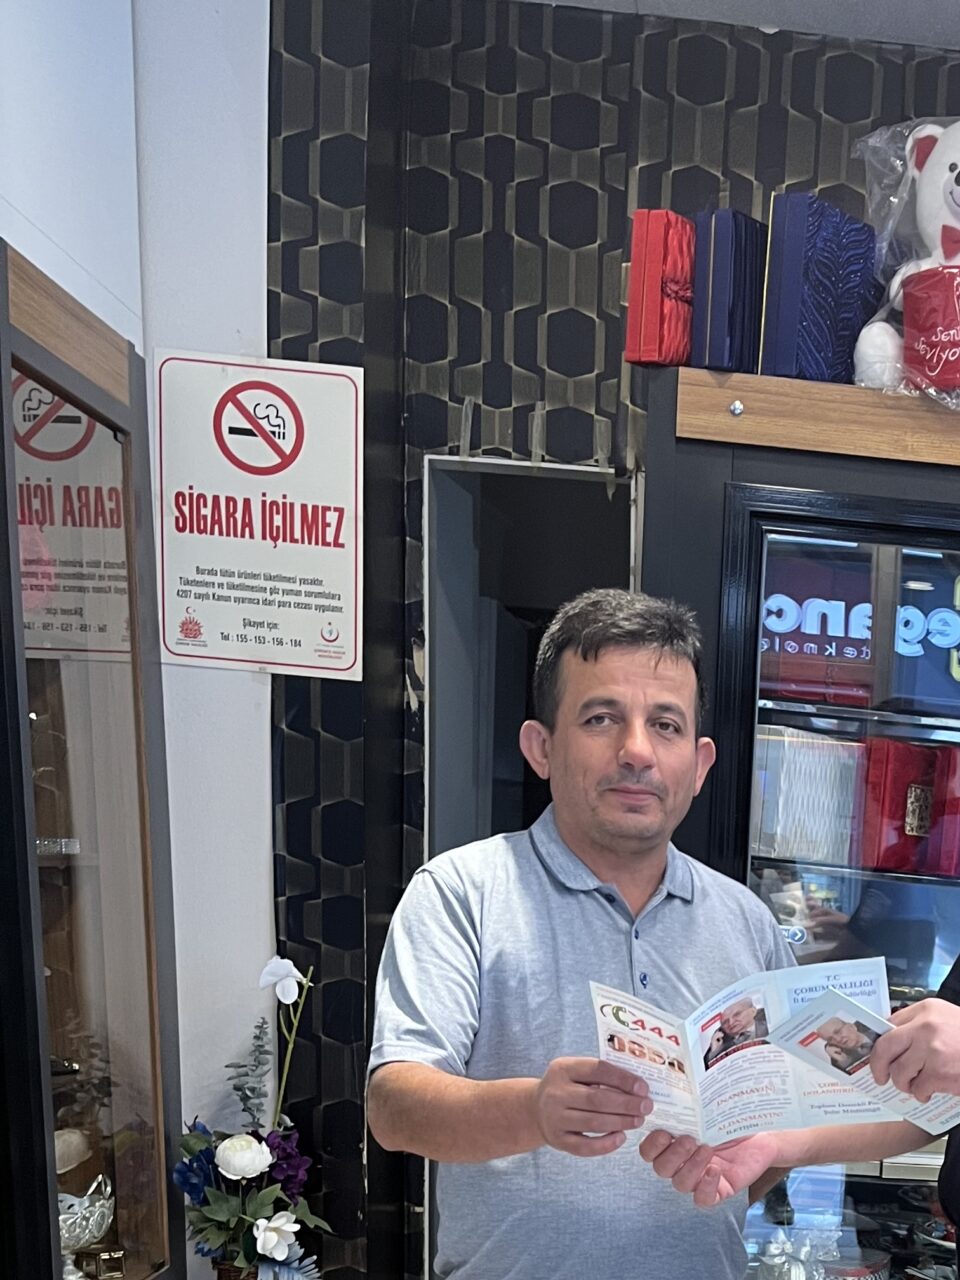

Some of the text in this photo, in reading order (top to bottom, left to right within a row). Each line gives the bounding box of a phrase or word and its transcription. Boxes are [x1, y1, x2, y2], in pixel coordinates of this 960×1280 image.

[174, 485, 346, 549] SİGARA İÇİLMEZ
[196, 566, 218, 576] Burada
[177, 589, 192, 599] 4207
[243, 618, 265, 629] Şikayet
[220, 632, 302, 647] Tel 155 153 156 184
